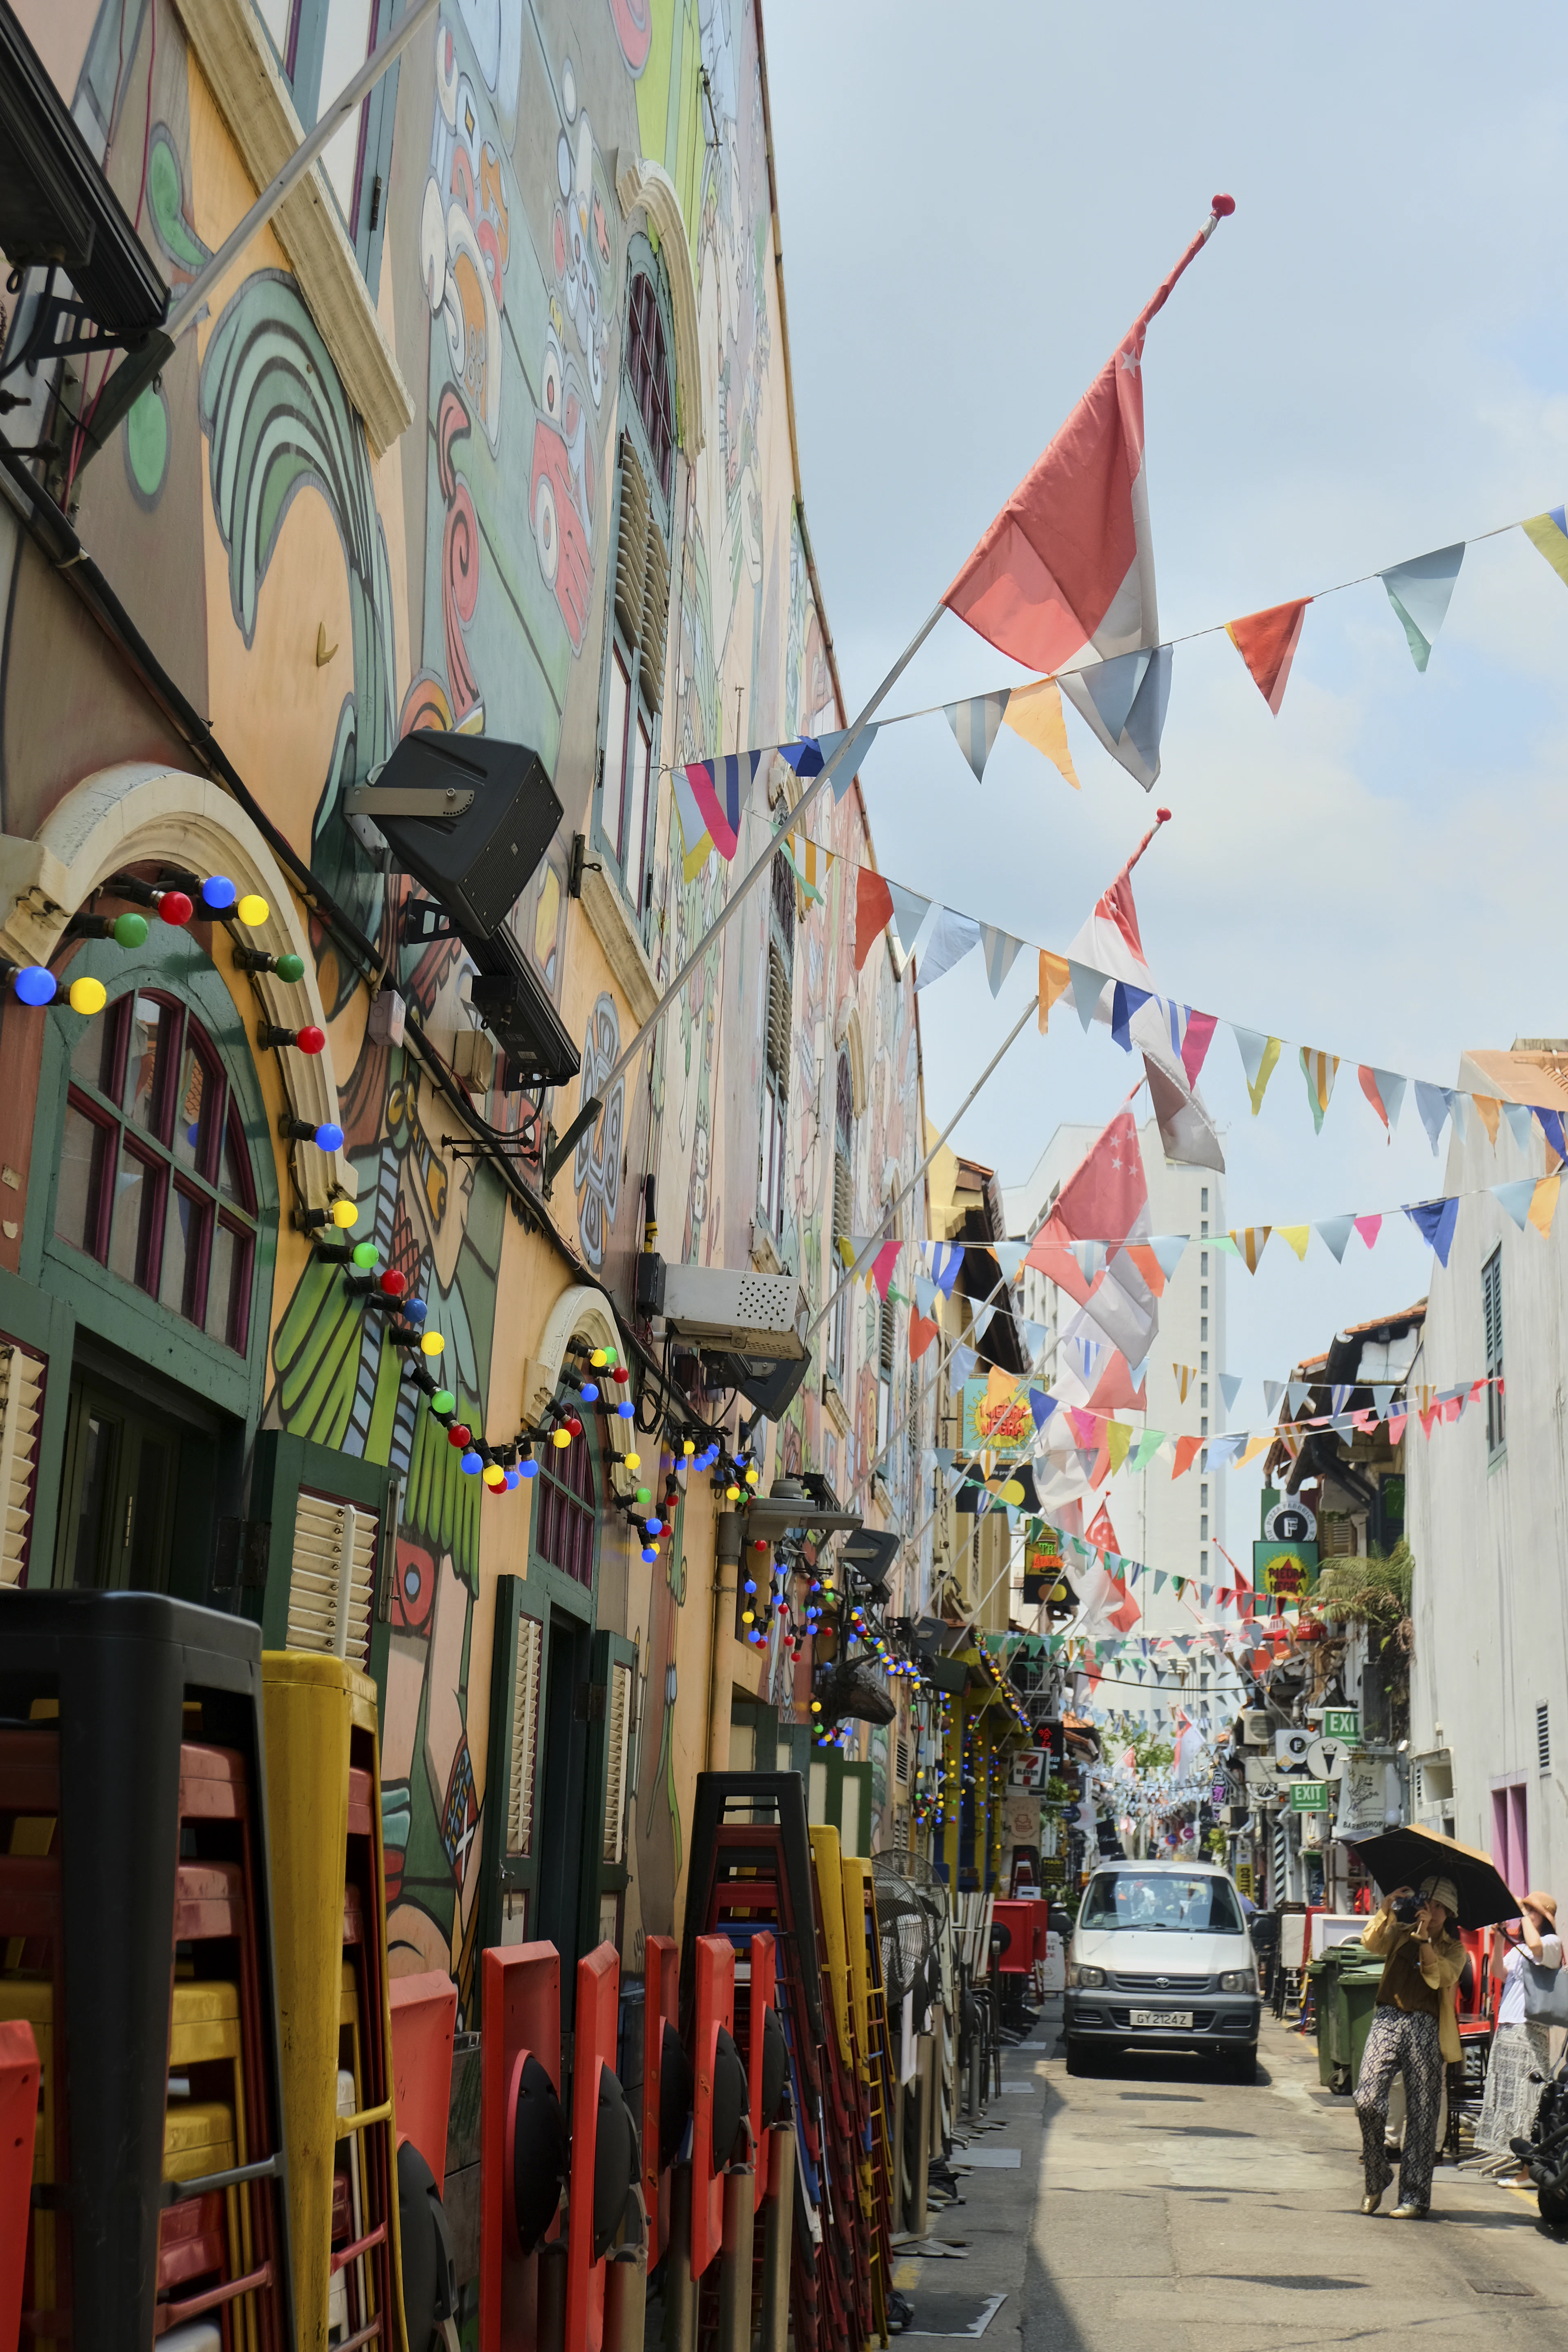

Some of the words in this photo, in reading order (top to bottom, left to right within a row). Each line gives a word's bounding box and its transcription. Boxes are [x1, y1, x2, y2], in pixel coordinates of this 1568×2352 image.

[981, 1421, 1024, 1436] NEGRA
[1268, 1568, 1306, 1579] PIEDRA
[1330, 1713, 1359, 1732] EXI
[1295, 1786, 1322, 1800] EXIT
[1138, 2014, 1150, 2023] GY
[1153, 2014, 1177, 2025] 2124
[1180, 2016, 1186, 2025] Z
